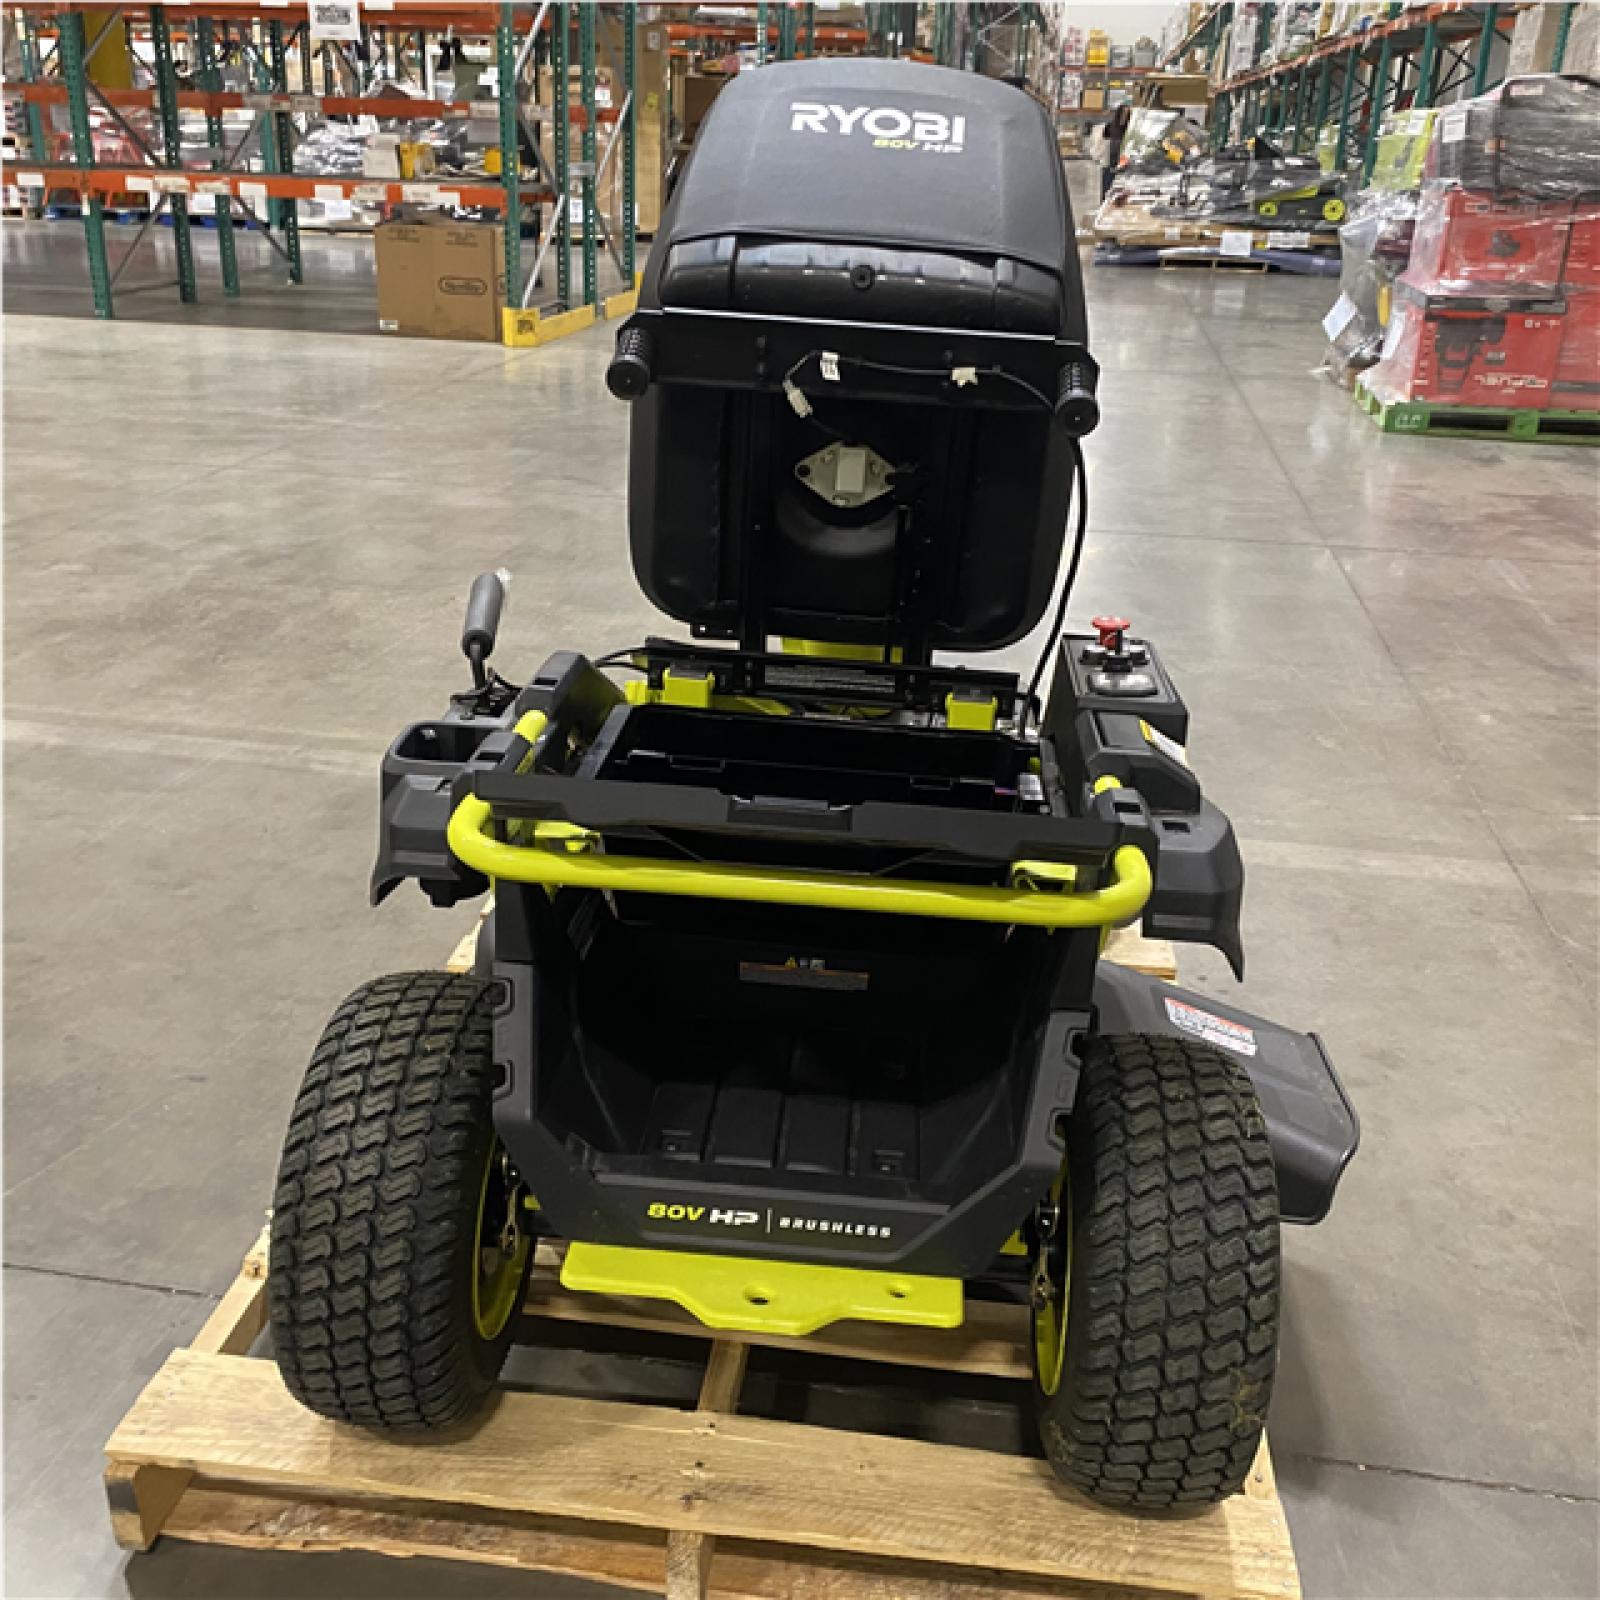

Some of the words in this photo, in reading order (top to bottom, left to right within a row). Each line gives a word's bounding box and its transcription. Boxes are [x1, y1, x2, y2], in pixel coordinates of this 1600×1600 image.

[790, 101, 966, 145] RYOBI
[647, 1202, 705, 1222] 80V
[709, 1206, 761, 1226] HP
[779, 1216, 892, 1239] BRUSHLESS
